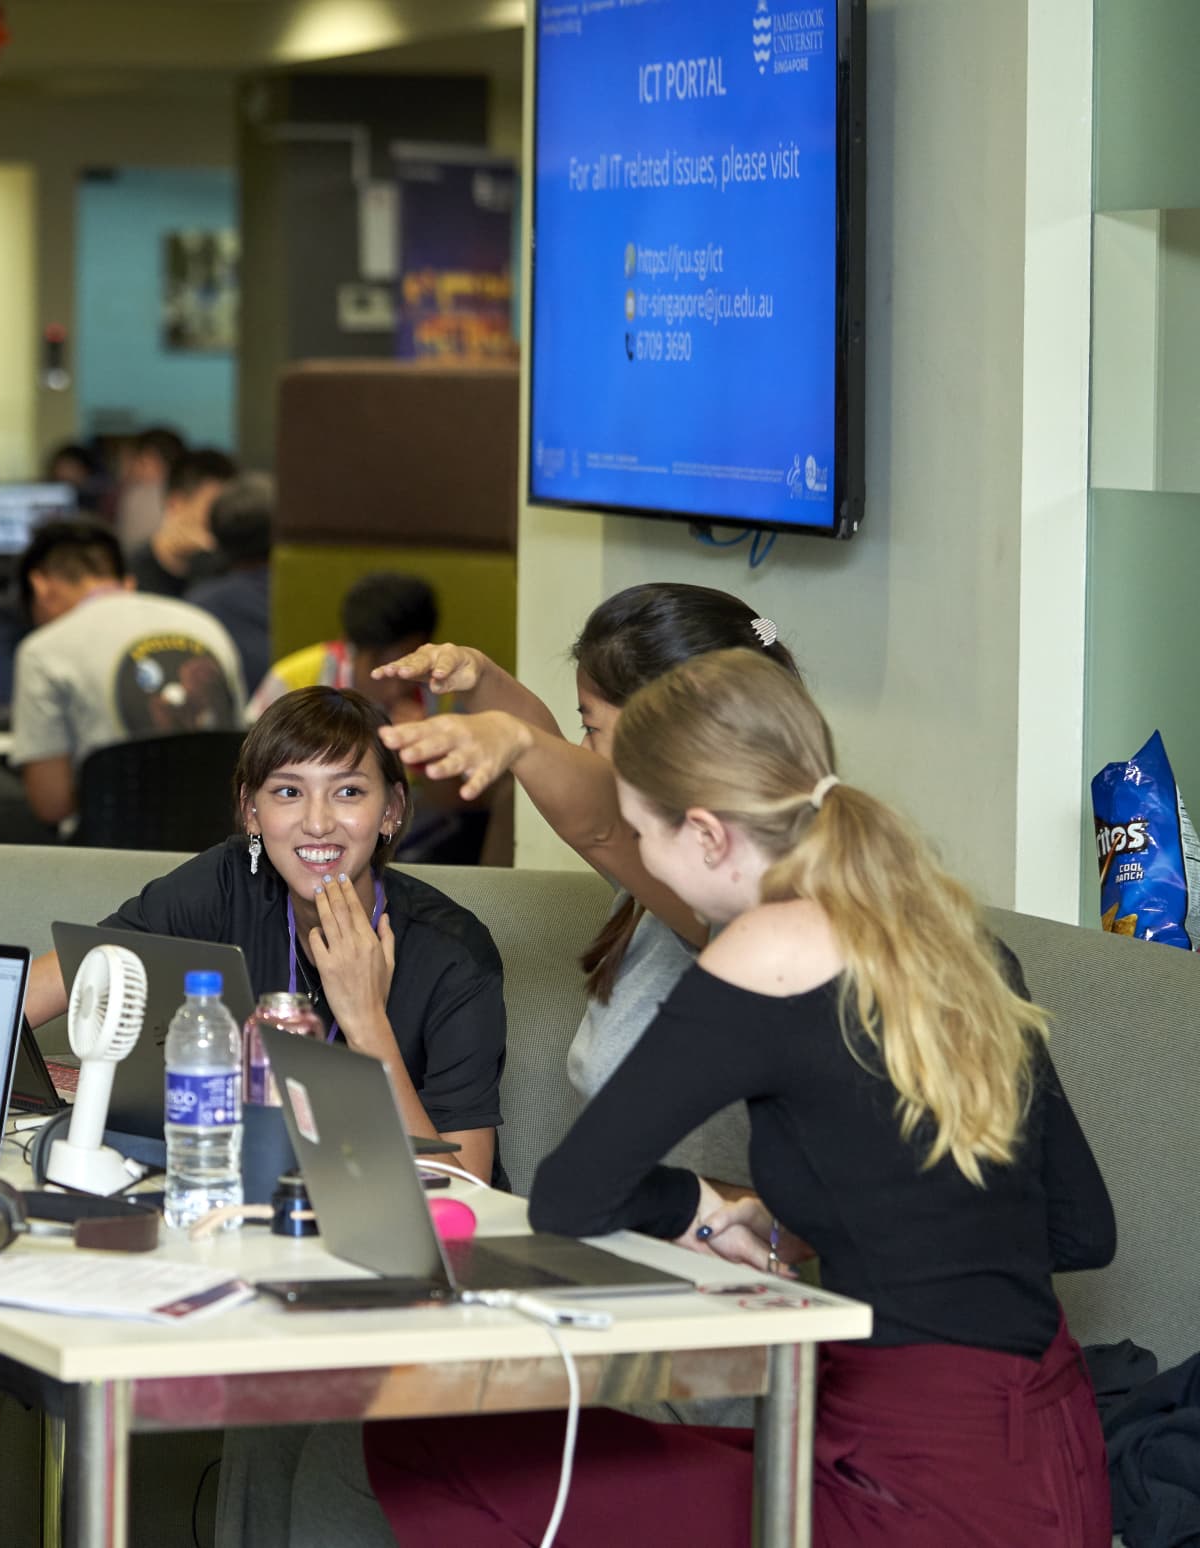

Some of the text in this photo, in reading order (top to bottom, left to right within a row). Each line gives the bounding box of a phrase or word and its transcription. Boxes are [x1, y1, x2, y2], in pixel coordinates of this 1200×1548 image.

[773, 8, 825, 33] JAMES COOK
[773, 30, 824, 54] UNIVERSITY
[773, 56, 809, 74] SINGAPORE
[638, 55, 727, 104] ICT PORTAL
[569, 140, 800, 193] For all IT related issues, please visit
[637, 241, 724, 282] https://jcu.sg/ict
[636, 331, 662, 361] 6709
[1119, 862, 1143, 873] COOL
